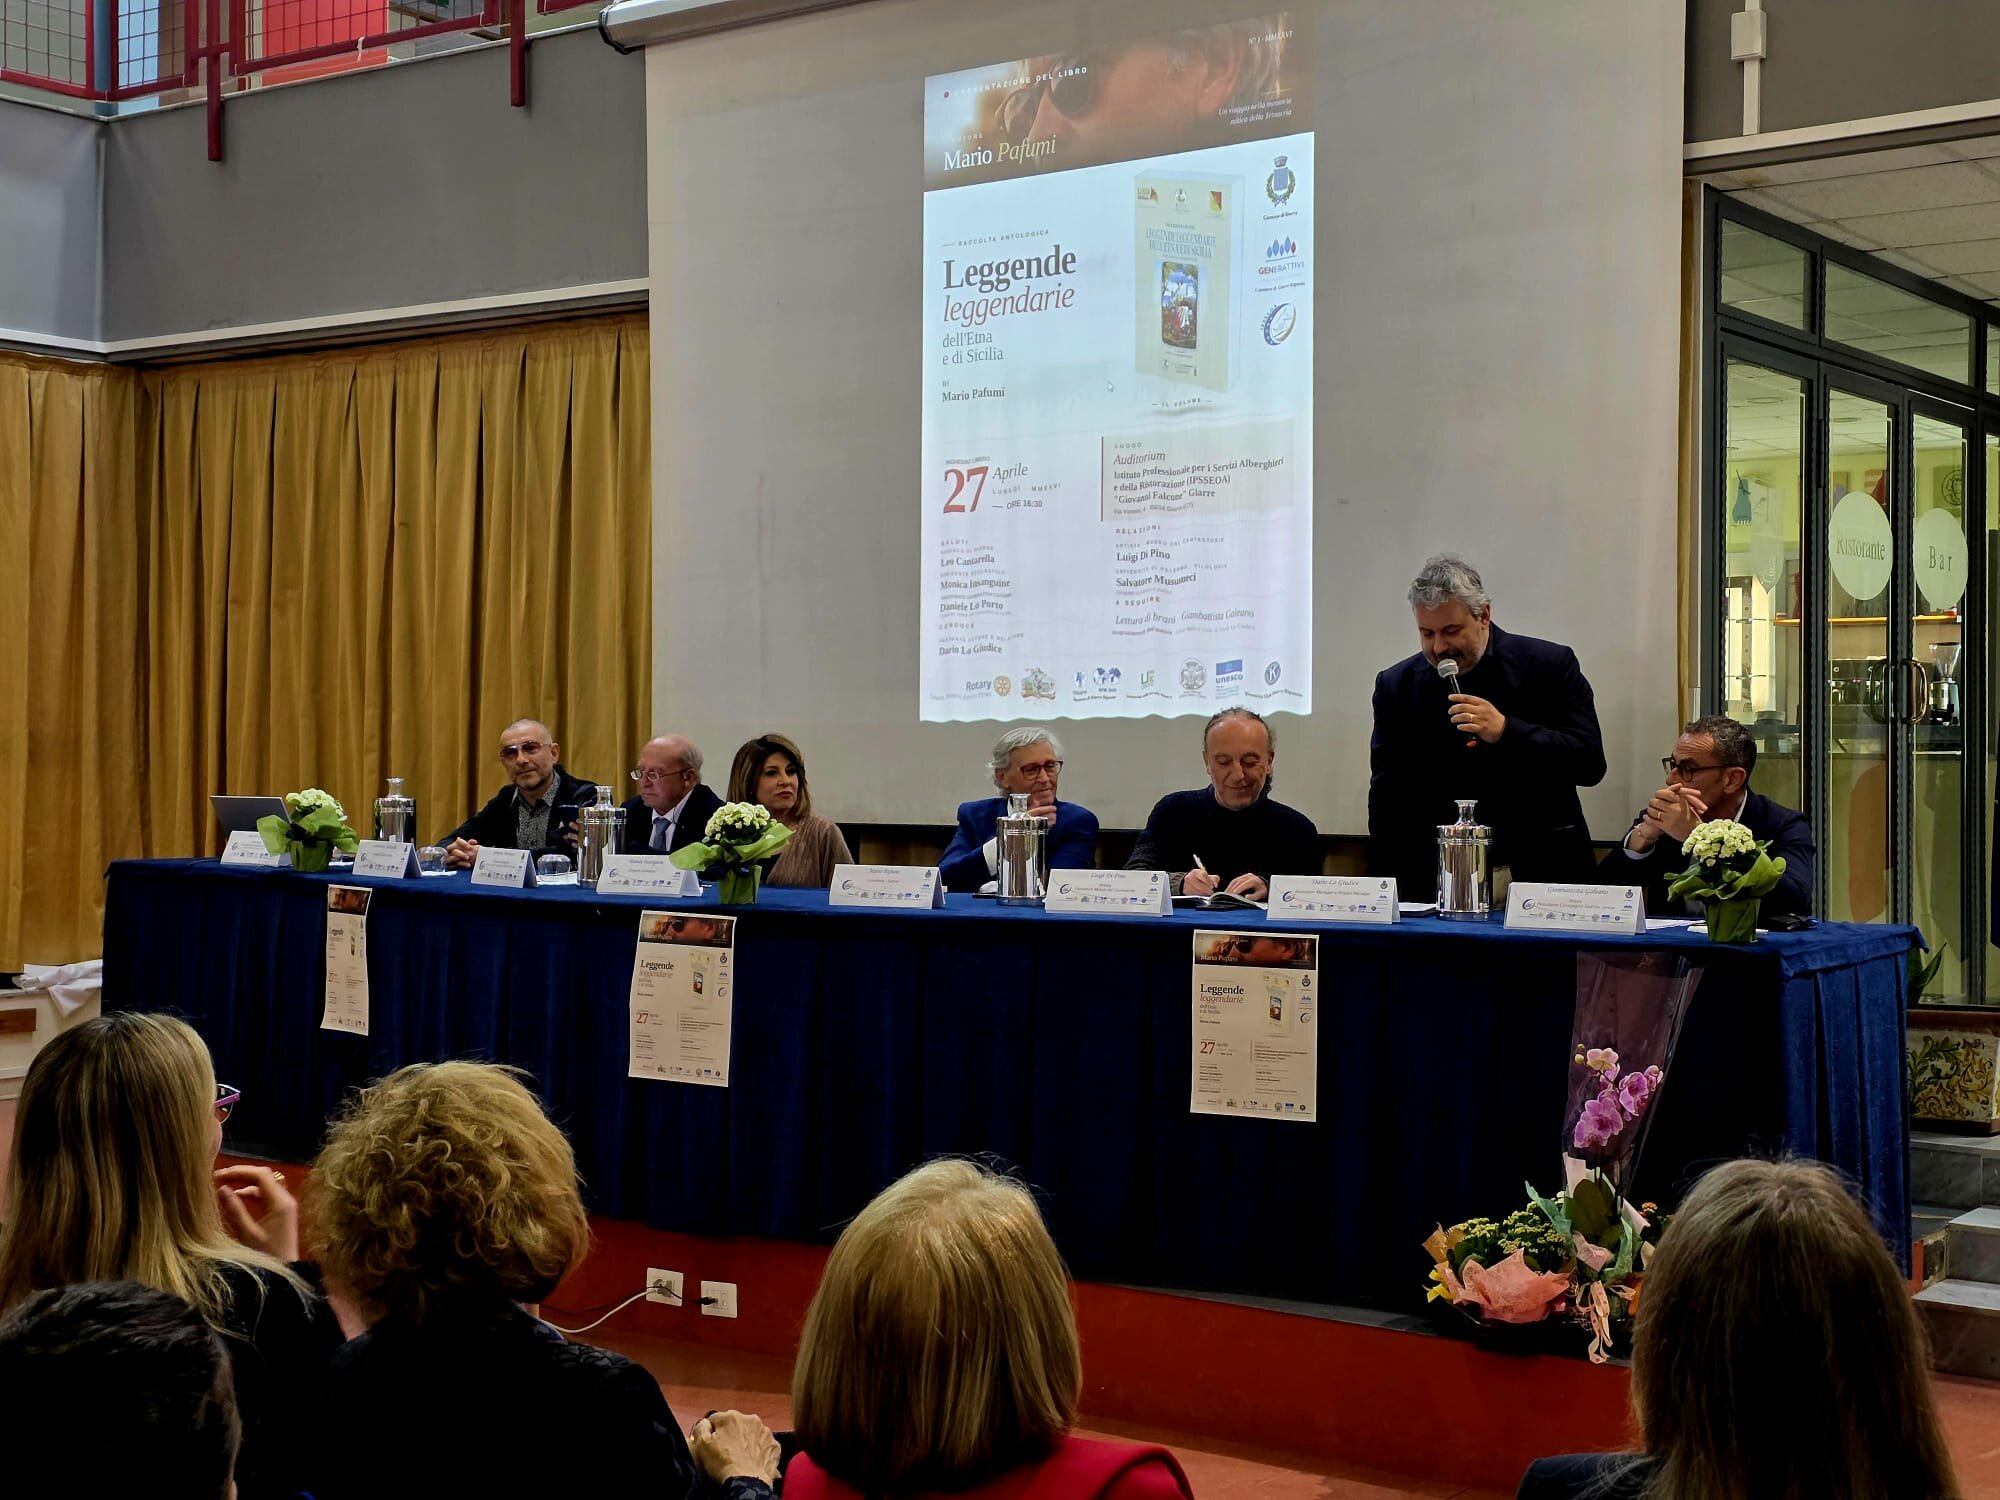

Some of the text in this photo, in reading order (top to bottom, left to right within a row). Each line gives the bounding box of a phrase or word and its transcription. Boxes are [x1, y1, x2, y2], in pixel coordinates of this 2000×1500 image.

[1036, 72, 1053, 82] DEL
[1058, 66, 1088, 78] LIBRO
[948, 133, 983, 143] UTORE
[944, 134, 1057, 171] Mario Pafumi
[958, 229, 1050, 246] RACCOLTA ANTOLOGICA
[942, 244, 1077, 293] Leggende
[1258, 261, 1304, 275] GENERATTIVI
[943, 282, 1075, 328] leggendarie
[942, 331, 993, 348] dell'Etna
[942, 347, 1004, 365] e di Sicilia
[942, 387, 1005, 402] Mario Pafumi
[1113, 451, 1166, 465] Auditorium
[1114, 471, 1141, 480] Istituto
[1142, 465, 1190, 478] Professionale
[1192, 464, 1206, 474] per
[1213, 461, 1238, 472] Servizi
[1239, 455, 1284, 471] Alberghieri
[943, 462, 1029, 513] 27 Aprile
[1119, 482, 1138, 492] della
[1139, 479, 1185, 491] Ristorazione
[1186, 475, 1231, 487] (IPSSEOA)
[1114, 488, 1215, 504] "Giovanni Falcone" Giarre
[1007, 499, 1043, 510] ORE 16:30
[1115, 524, 1161, 535] RELAZIONI
[1117, 548, 1171, 563] Luigi Di Pino
[1836, 536, 1887, 561] Ristorante
[941, 554, 995, 567] Leo Cantarella
[1929, 545, 1953, 572] Bar
[940, 579, 1011, 590] Monica Insanguine
[1115, 572, 1197, 588] Salvatore Musumeci
[940, 600, 1004, 612] Daniele Lo Porto
[1115, 608, 1256, 625] Lettura di brani Giambattista Galeano
[939, 643, 1003, 656] Dario Lo Giudice
[965, 679, 992, 692] Rotary
[1215, 673, 1244, 684] unesco
[640, 959, 674, 971] Leggende
[1200, 954, 1217, 962] Mario
[1200, 984, 1244, 996] Leggende
[1199, 994, 1244, 1005] leggendarie
[636, 1012, 649, 1024] 27
[1200, 1041, 1216, 1055] 27
